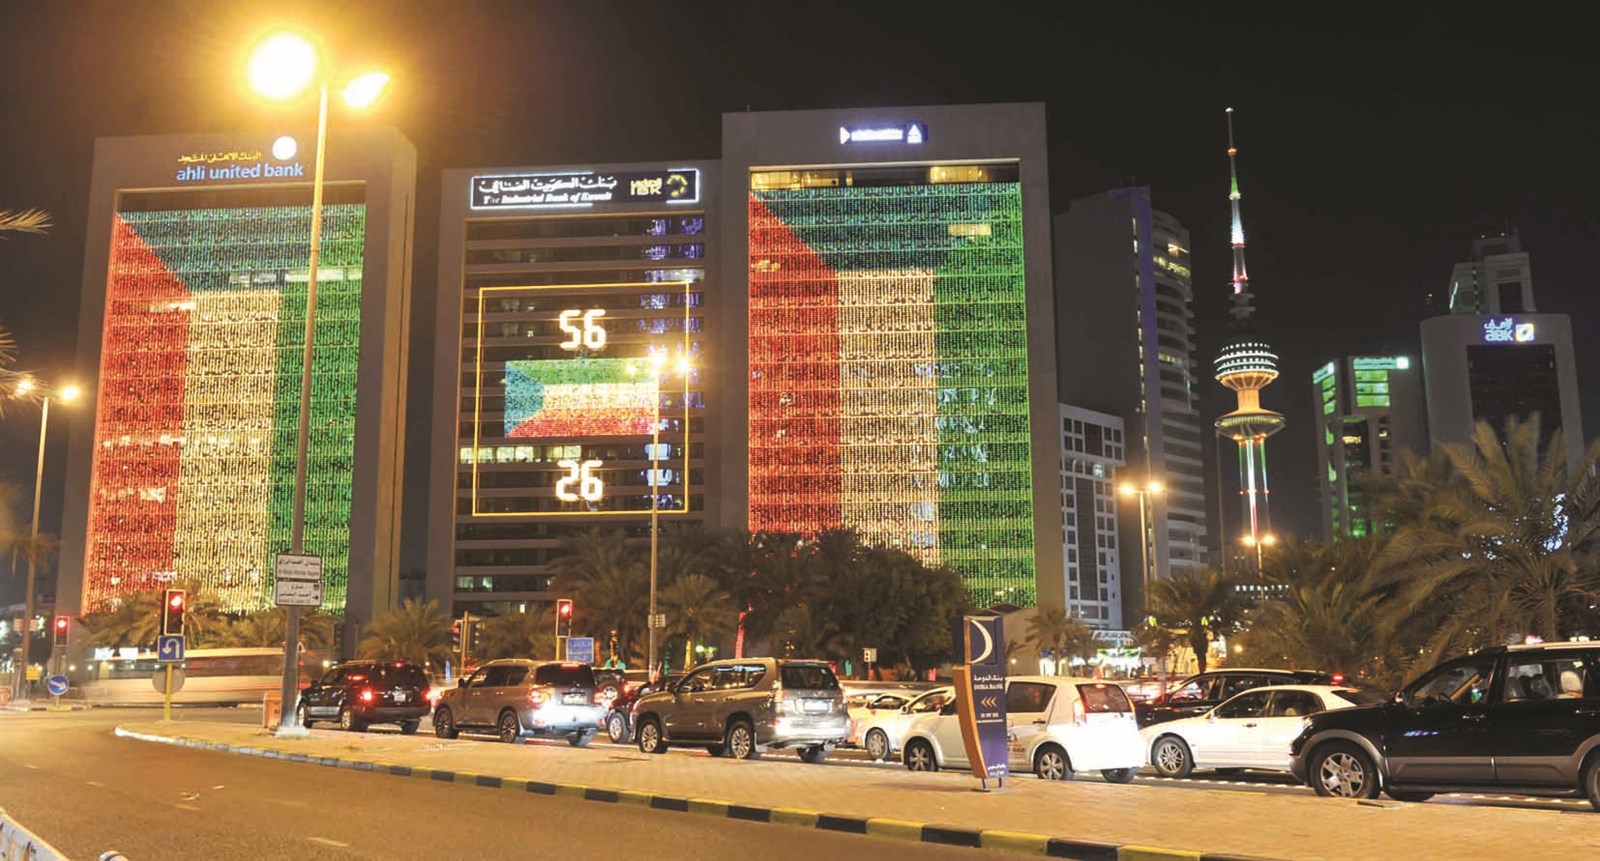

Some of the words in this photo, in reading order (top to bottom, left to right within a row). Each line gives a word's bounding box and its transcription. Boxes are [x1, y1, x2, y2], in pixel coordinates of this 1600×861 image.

[176, 165, 206, 180] ahli
[209, 164, 261, 180] united
[263, 161, 303, 178] bank
[545, 193, 569, 203] Bank
[569, 193, 580, 203] of
[559, 309, 606, 349] 56
[555, 460, 603, 501] 26
